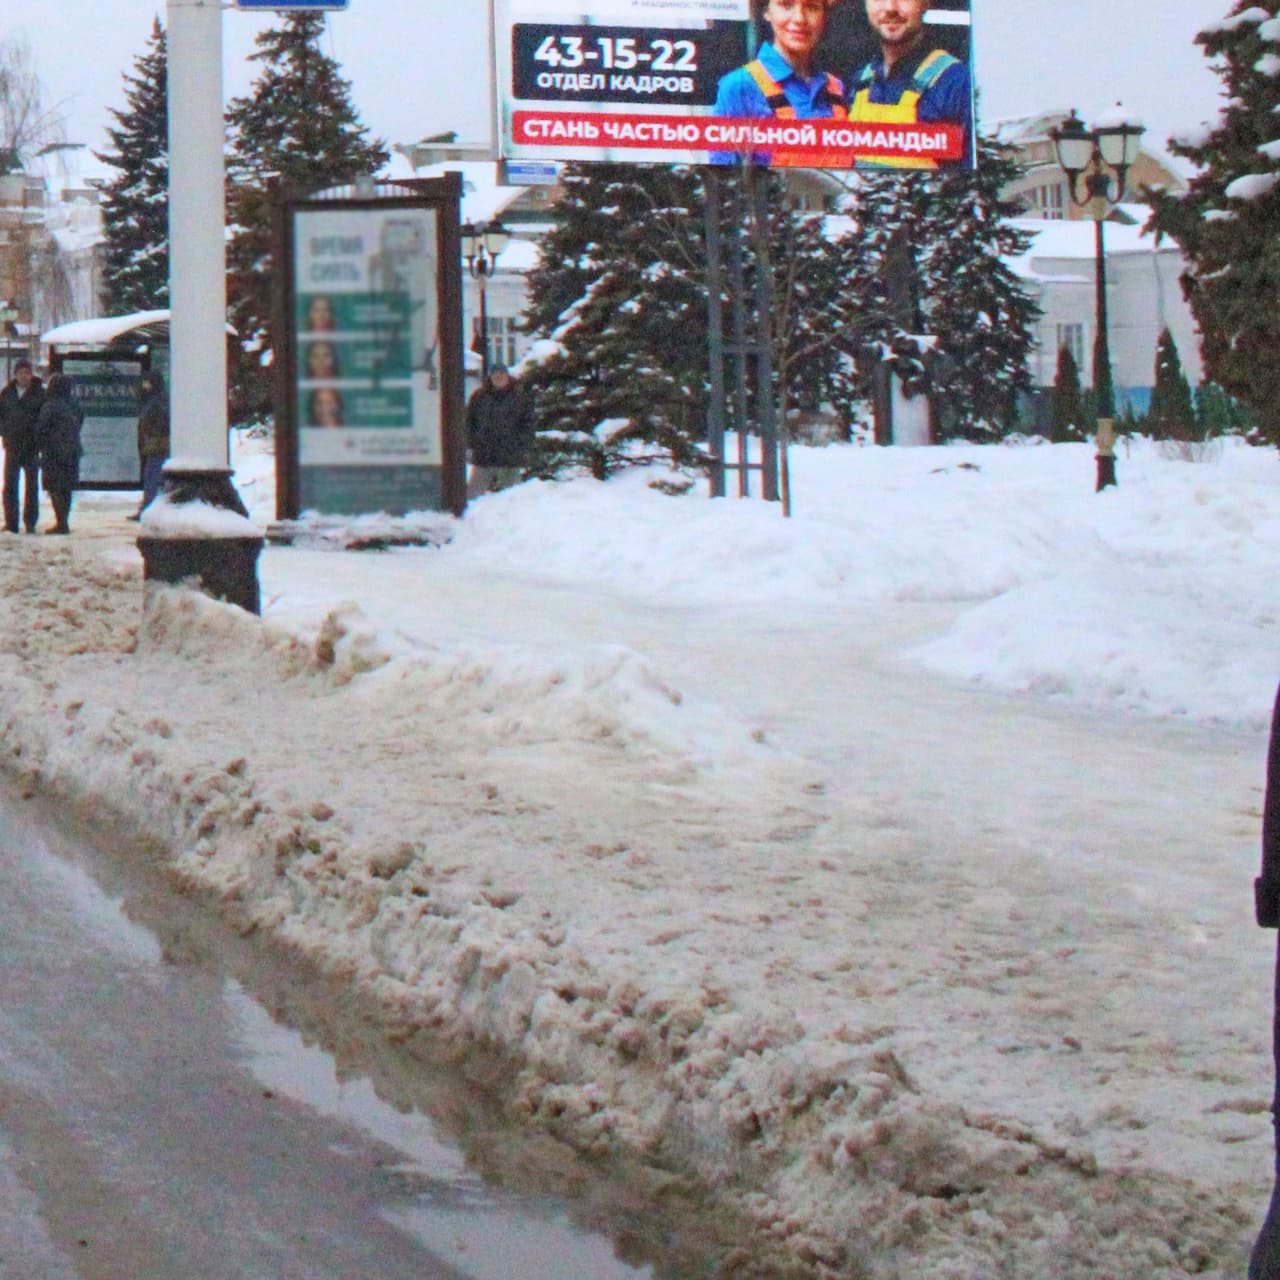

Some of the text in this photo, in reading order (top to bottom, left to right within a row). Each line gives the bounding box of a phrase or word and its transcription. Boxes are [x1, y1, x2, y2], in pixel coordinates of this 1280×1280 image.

[534, 36, 697, 71] 43-15-22
[537, 73, 693, 93] ОТДЕЛ КАДРОВ
[524, 120, 947, 151] СТАНЬ ЧАСТЬЮ СИЛЬНОЙ КОМАНДЫ!
